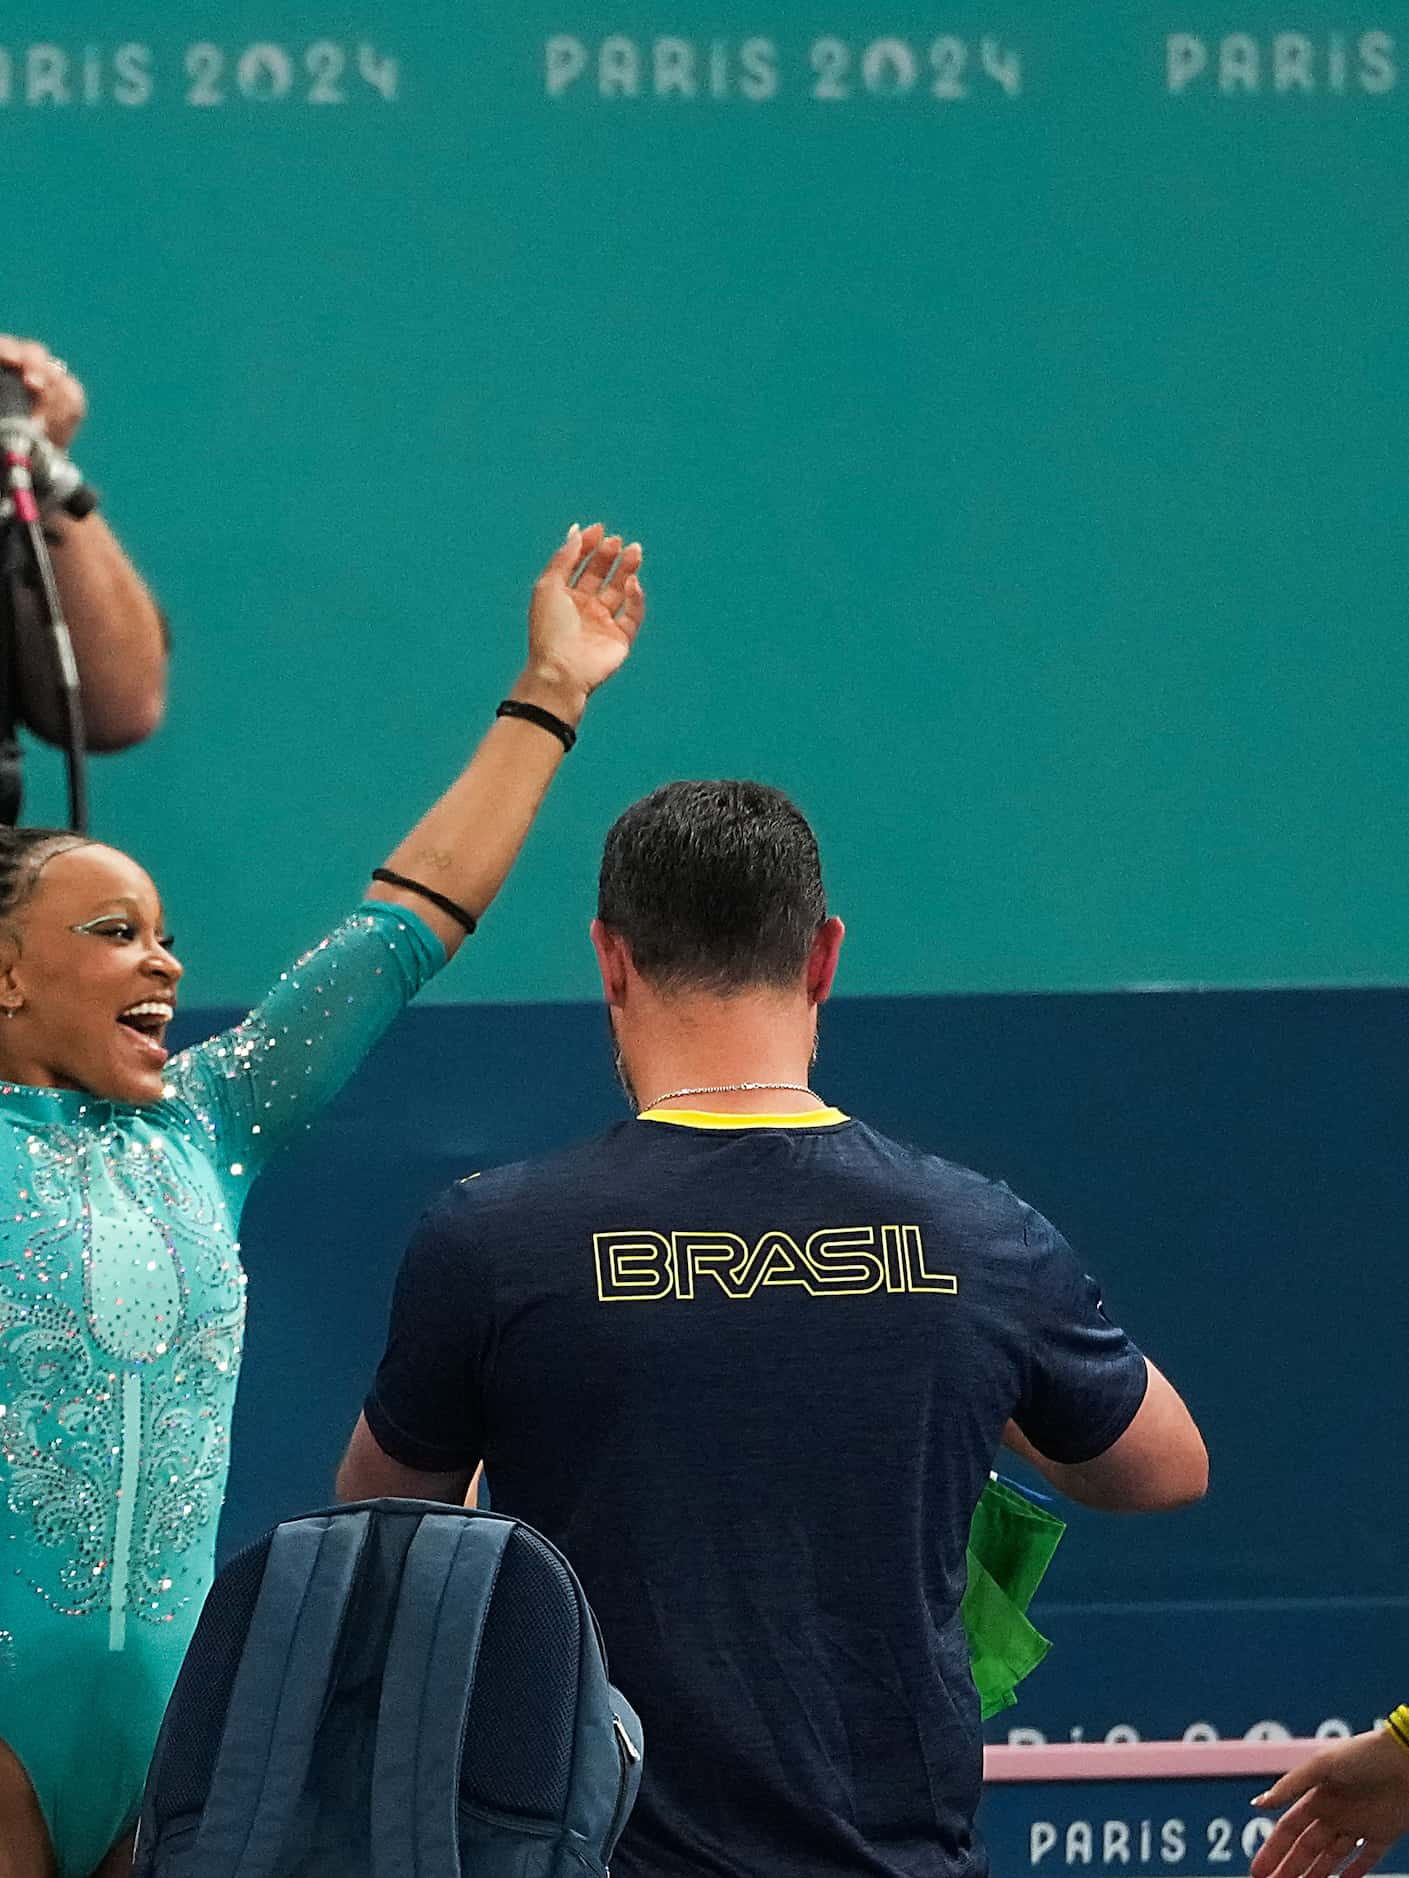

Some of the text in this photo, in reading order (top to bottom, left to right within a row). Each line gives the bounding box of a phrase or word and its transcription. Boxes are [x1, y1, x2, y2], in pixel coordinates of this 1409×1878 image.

[185, 41, 399, 106] 2024
[544, 34, 1021, 101] PARIS 2024
[1165, 30, 1397, 94] PARIS
[592, 1225, 958, 1301] BRASIL
[1030, 1816, 1277, 1864] PARIS 20
